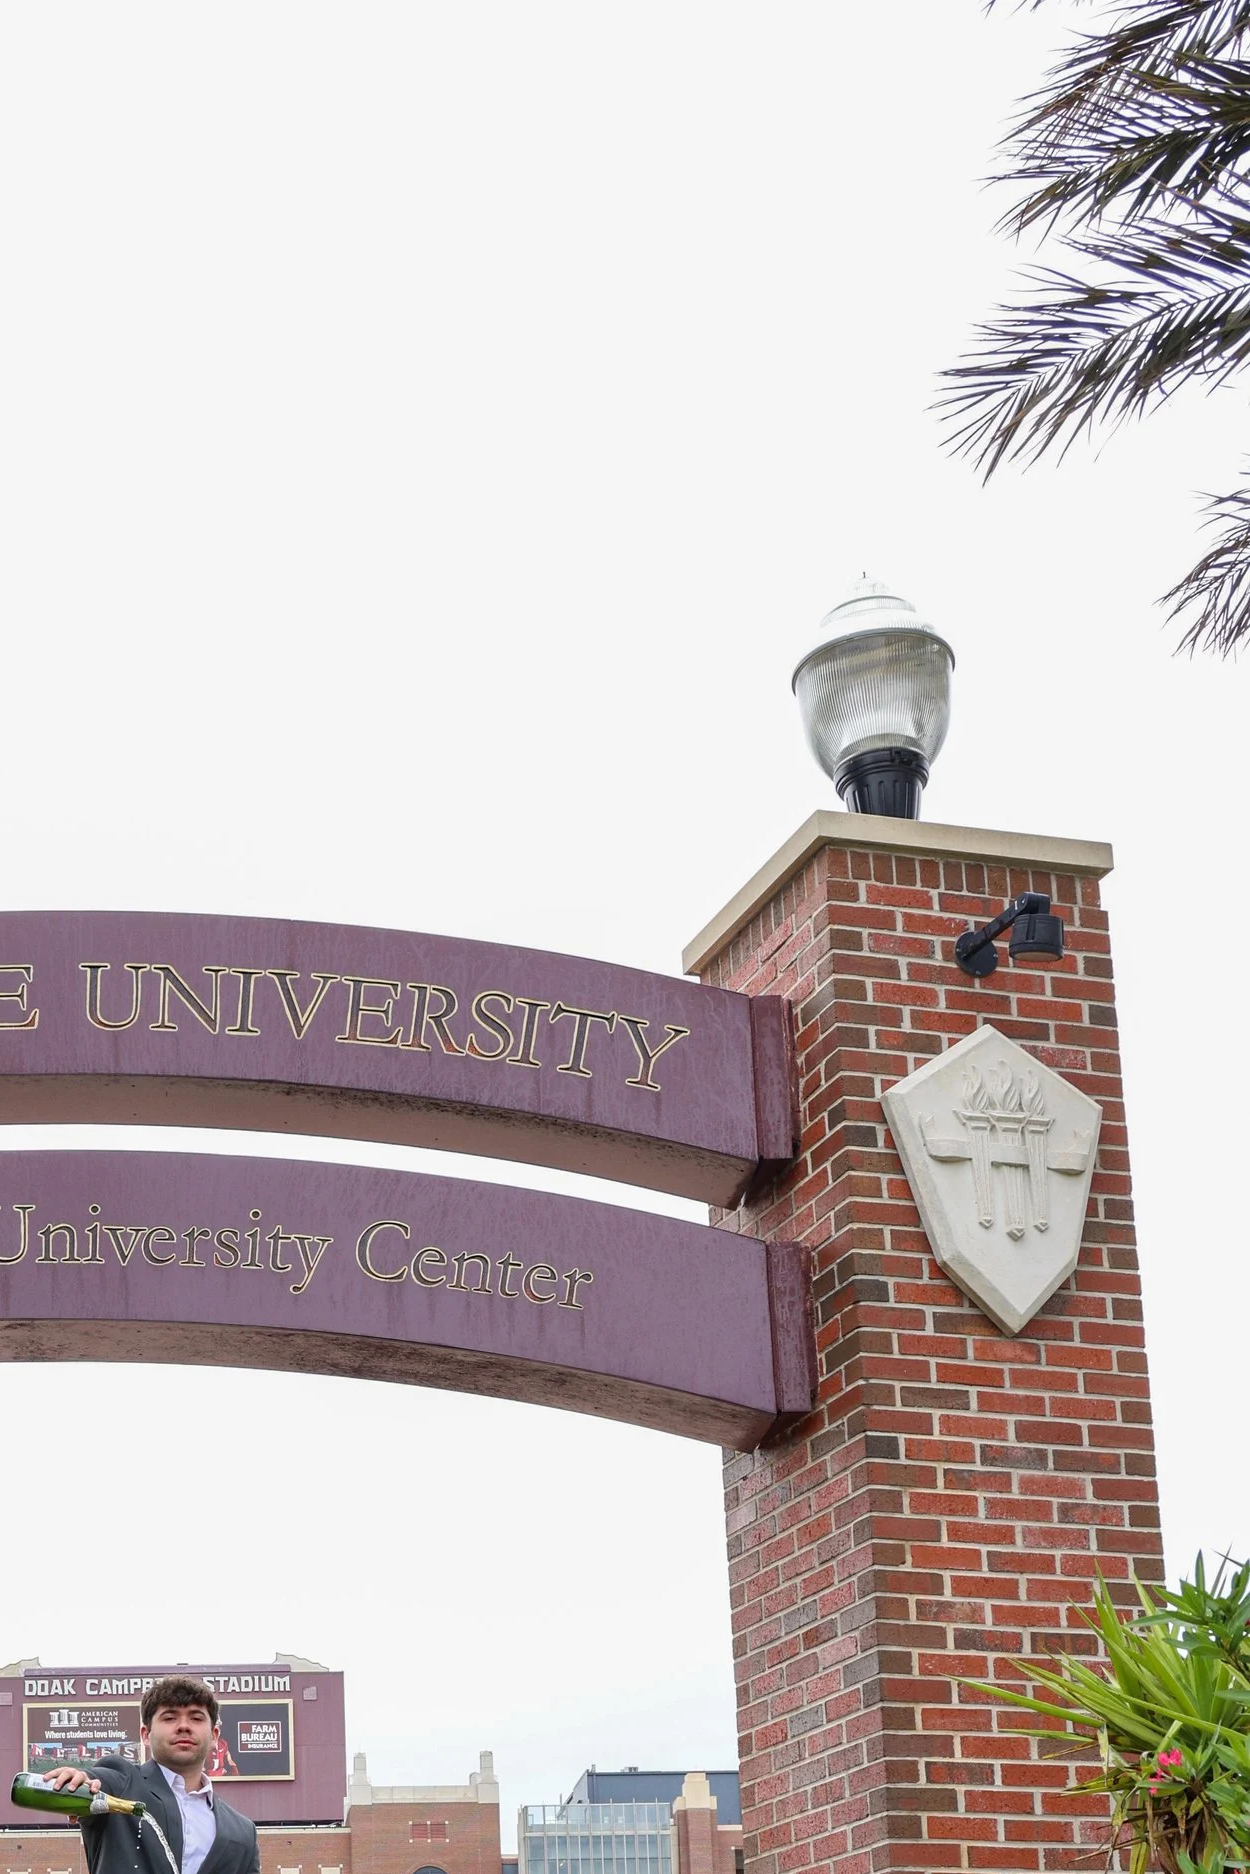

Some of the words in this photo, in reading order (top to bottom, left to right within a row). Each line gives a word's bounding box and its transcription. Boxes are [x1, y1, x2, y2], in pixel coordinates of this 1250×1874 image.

[79, 962, 690, 1091] UNIVERSITY
[355, 1220, 594, 1310] Center
[24, 1678, 77, 1696] DOAK
[202, 1674, 291, 1693] STADIUM
[44, 1730, 66, 1739] Where
[66, 1730, 93, 1739] students
[94, 1730, 108, 1738] love
[251, 1724, 277, 1733] FARM
[241, 1733, 278, 1741] BUREAU
